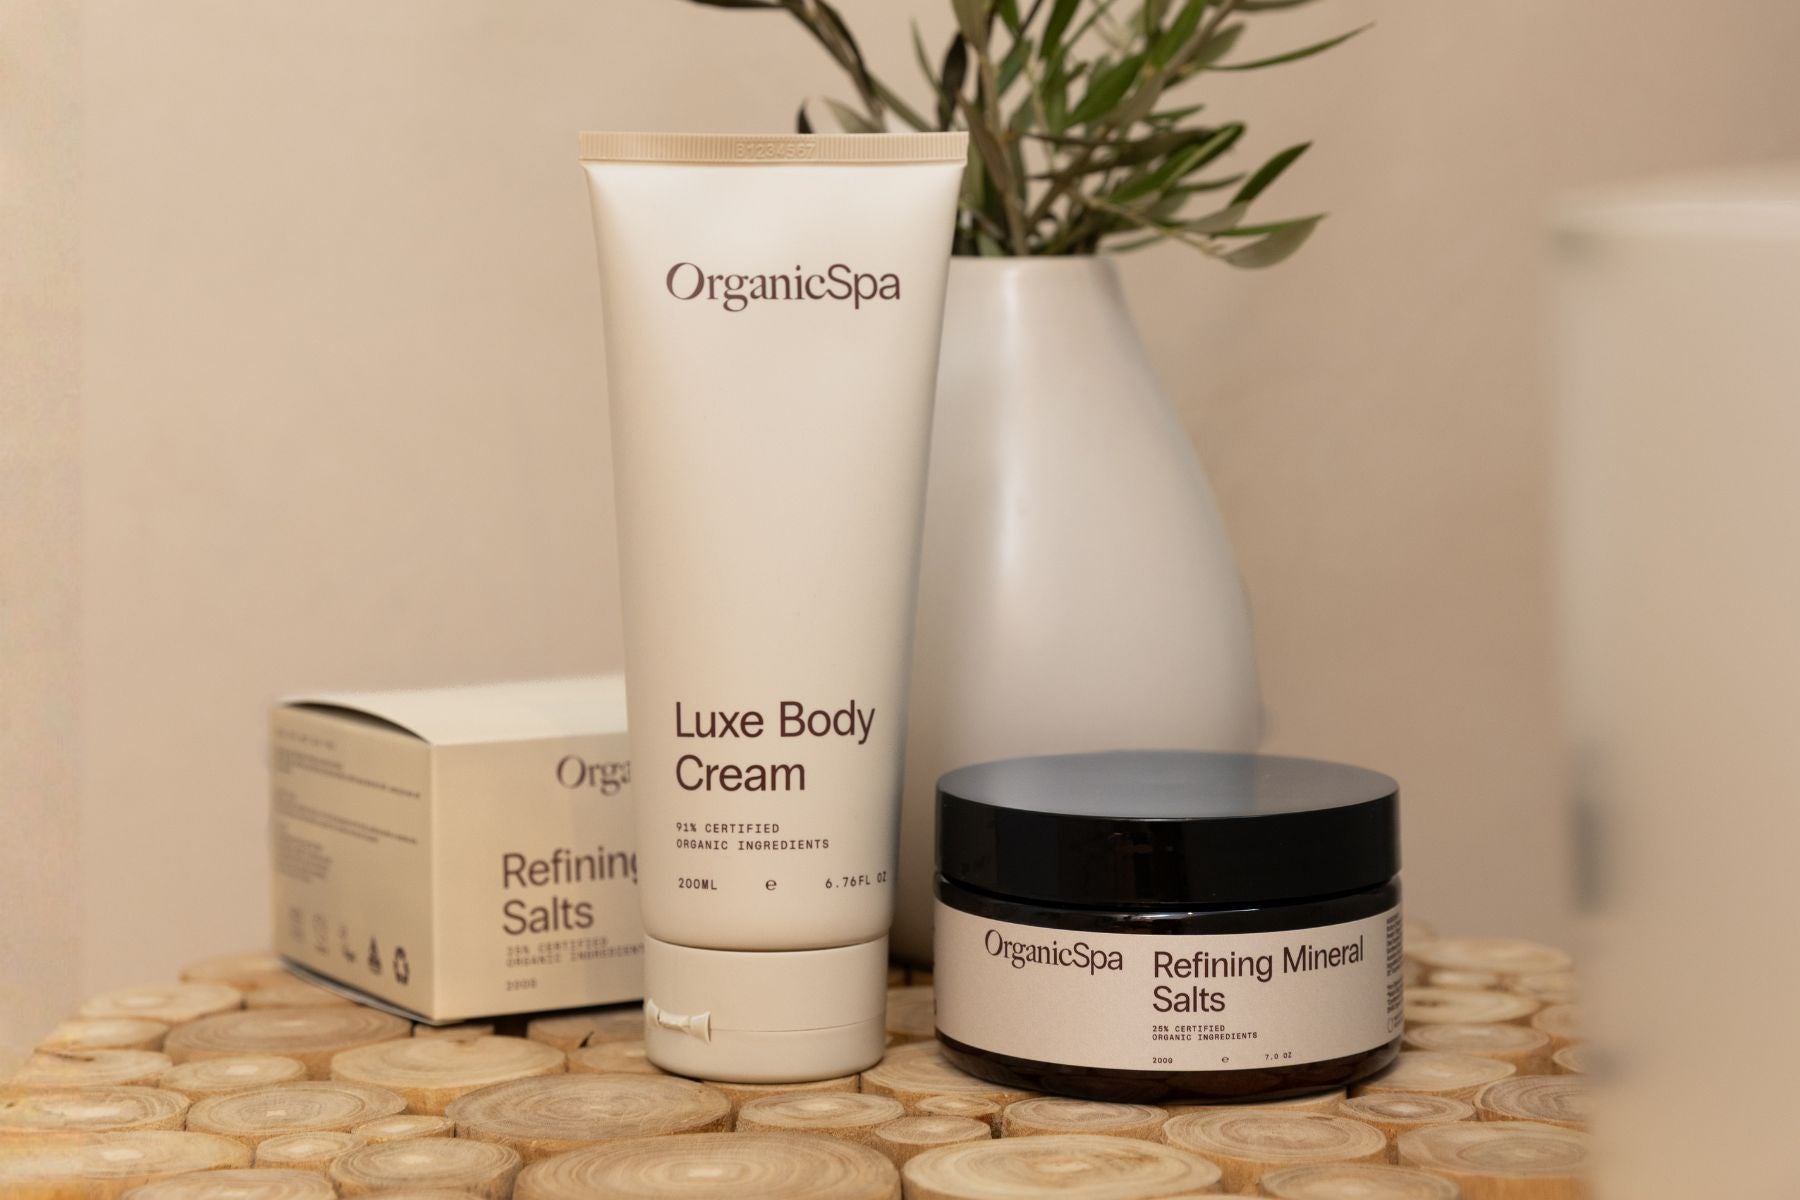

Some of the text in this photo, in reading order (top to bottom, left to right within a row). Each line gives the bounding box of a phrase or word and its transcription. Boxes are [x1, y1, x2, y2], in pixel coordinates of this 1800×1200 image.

[666, 262, 901, 312] OrganicSpa
[676, 700, 876, 745] Luxe Body
[676, 754, 806, 791] Cream
[676, 822, 780, 834] 91% CERTIFIED
[676, 838, 830, 851] ORGANIC INGREDIENTS
[678, 877, 718, 891] 200ML
[502, 896, 595, 936] Salts
[985, 929, 1123, 976] OrganicSpa
[1154, 950, 1273, 983] Refining
[1283, 934, 1364, 973] Mineral
[1152, 985, 1226, 1013] Salts
[1174, 1025, 1225, 1033] CERTIFIED
[1197, 1032, 1258, 1041] INGREDIENTS
